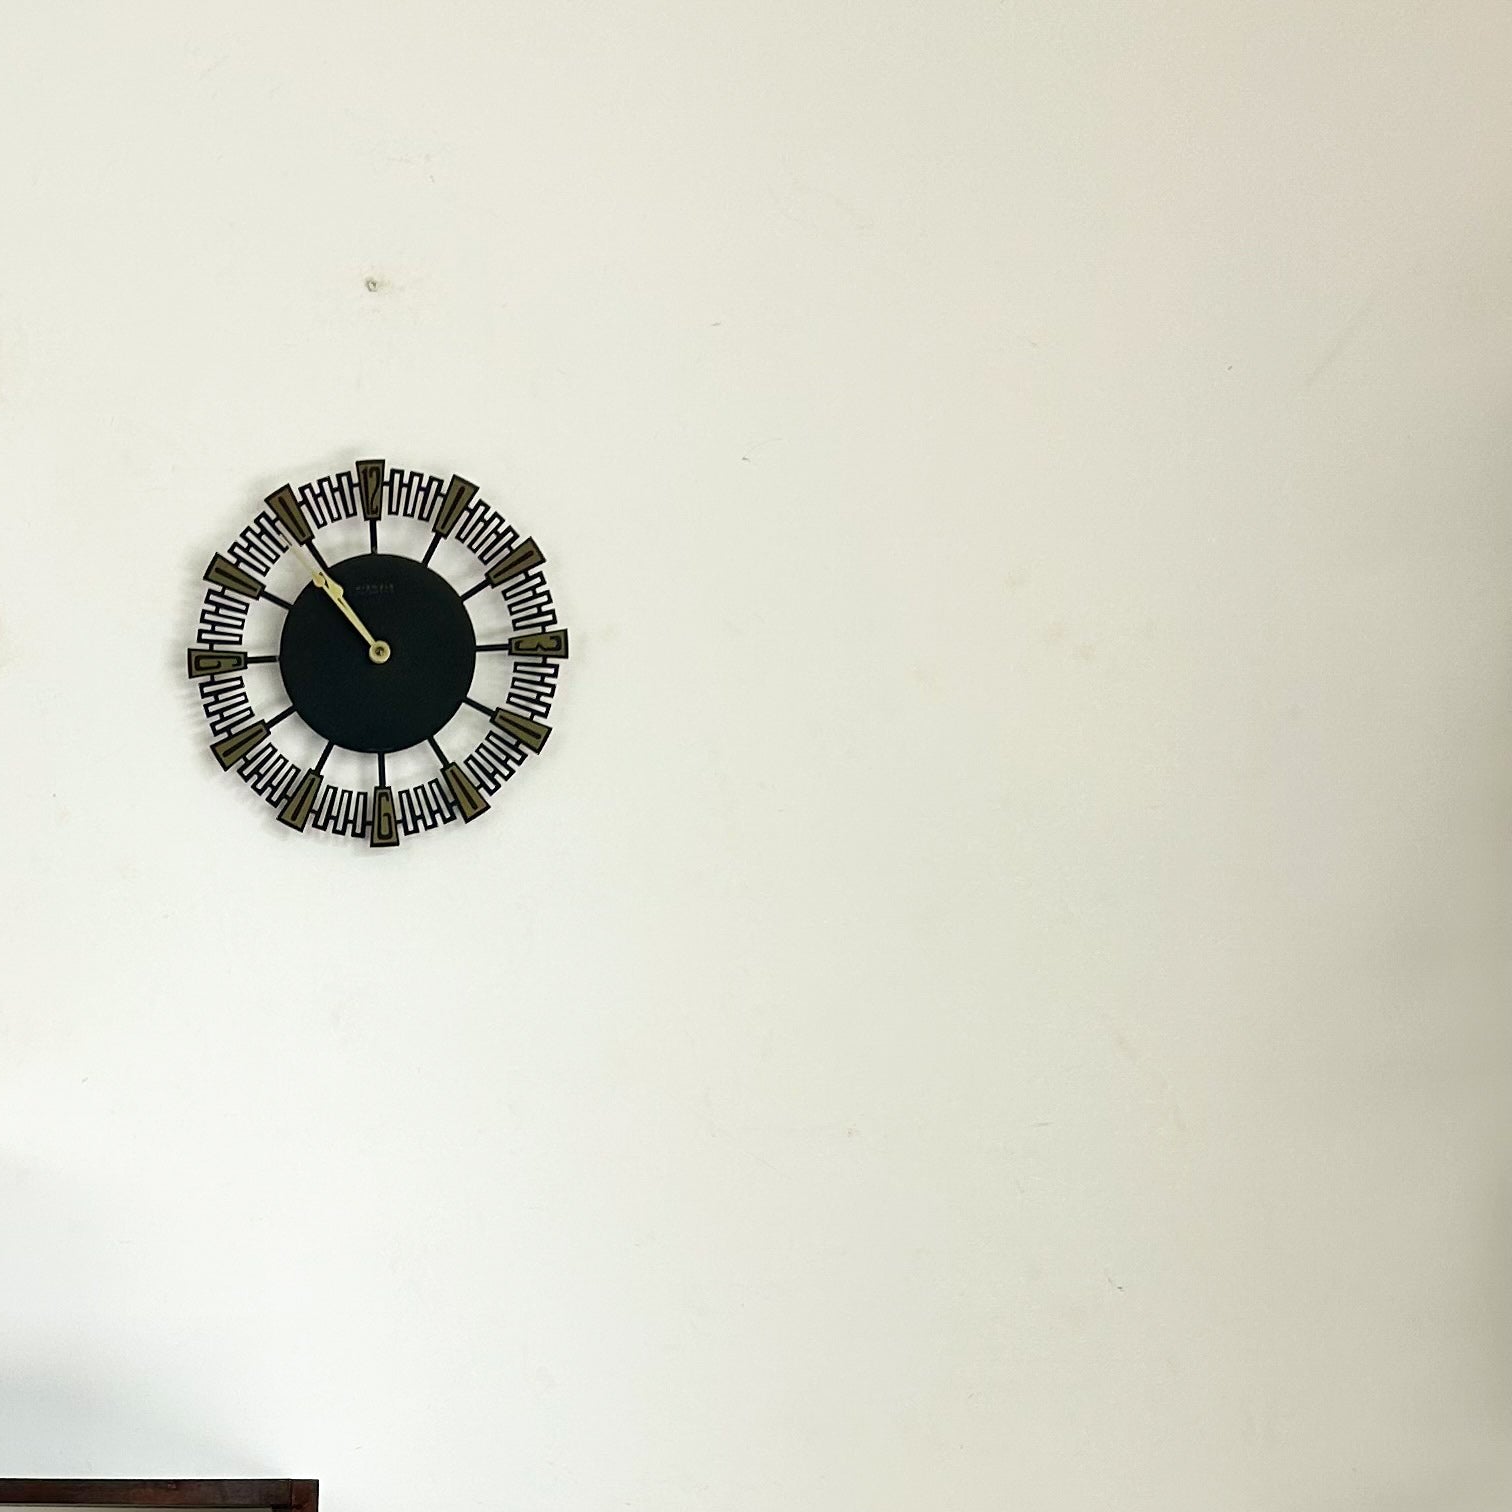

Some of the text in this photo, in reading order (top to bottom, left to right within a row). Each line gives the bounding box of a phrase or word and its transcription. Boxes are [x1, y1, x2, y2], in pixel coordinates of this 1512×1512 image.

[361, 466, 380, 515] 12
[514, 635, 562, 651] 3
[377, 792, 393, 840] 6
